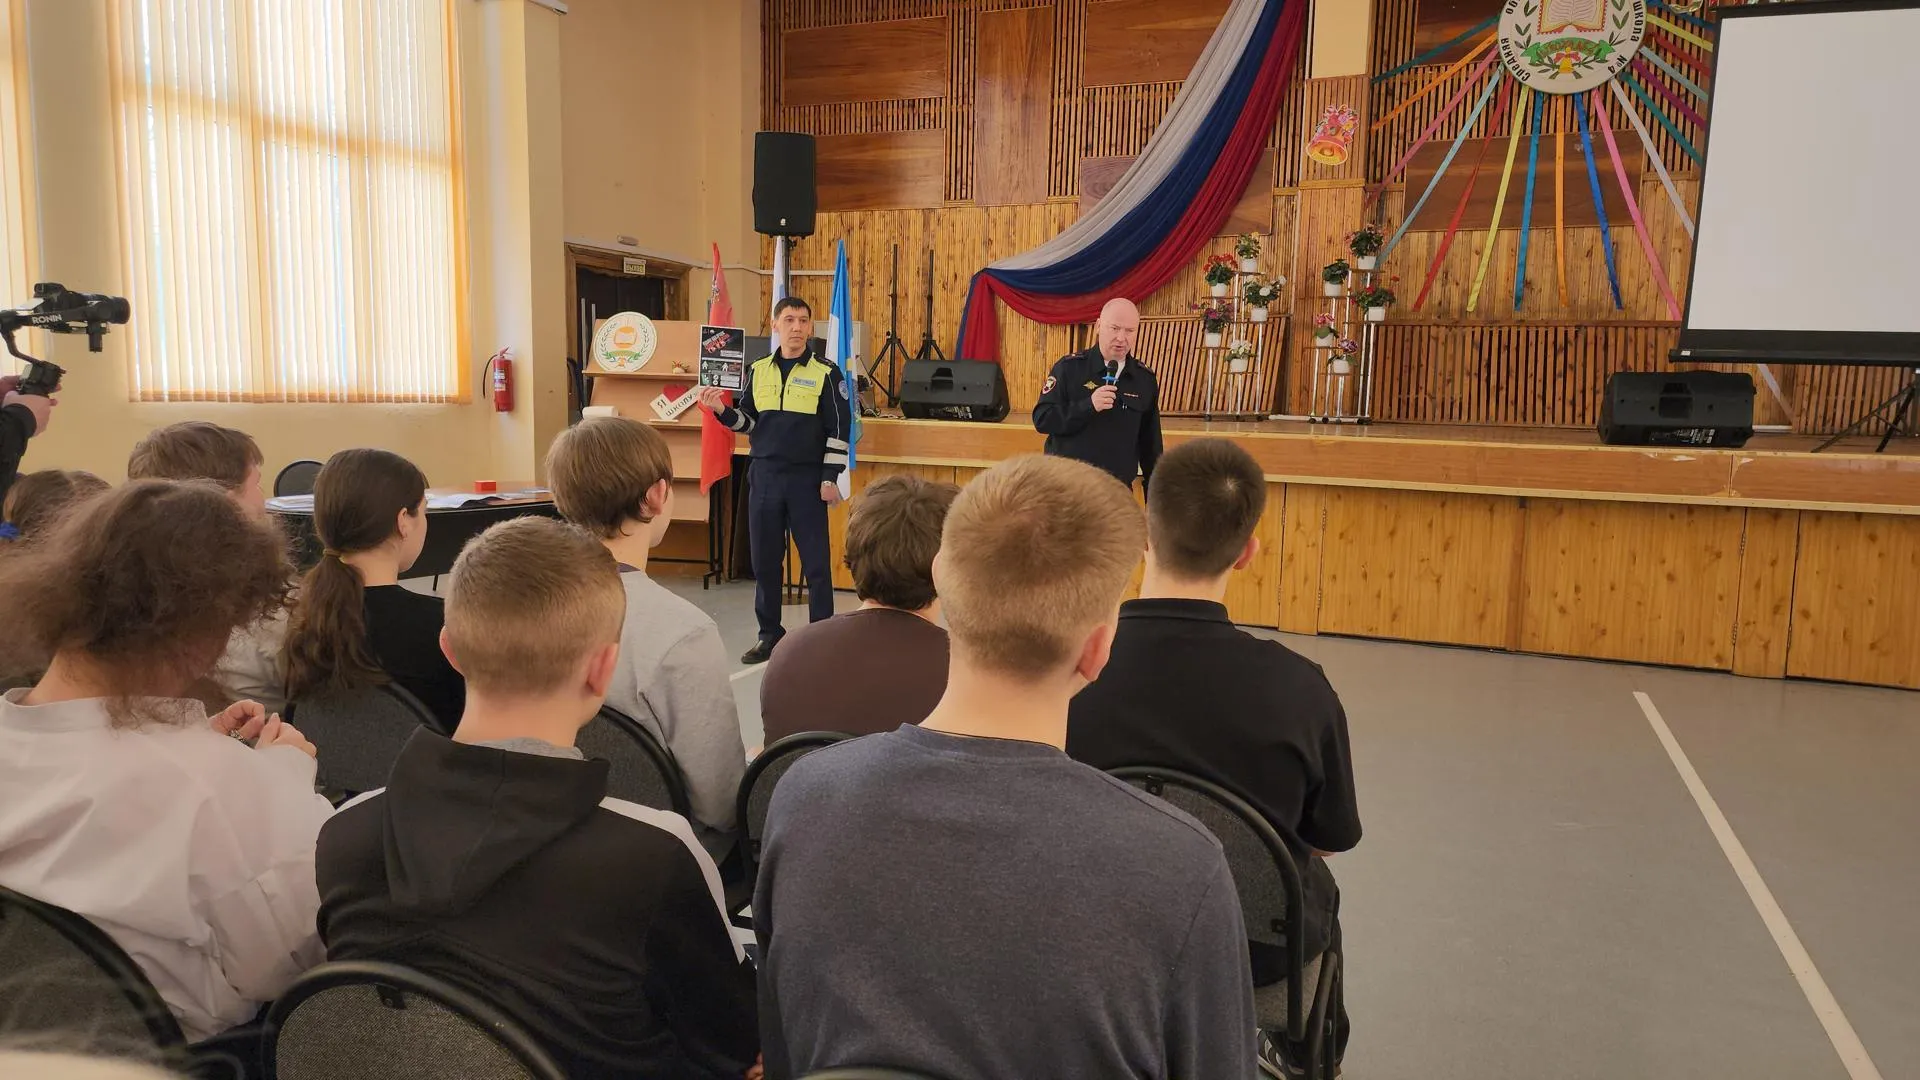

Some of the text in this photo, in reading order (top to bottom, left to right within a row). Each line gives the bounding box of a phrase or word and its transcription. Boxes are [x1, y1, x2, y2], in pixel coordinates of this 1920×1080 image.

[1505, 0, 1520, 15] об
[1631, 1, 1644, 42] школа
[1500, 37, 1531, 82] Средняя
[1607, 64, 1616, 74] 4
[32, 314, 62, 324] RONIN
[657, 398, 667, 409] Я
